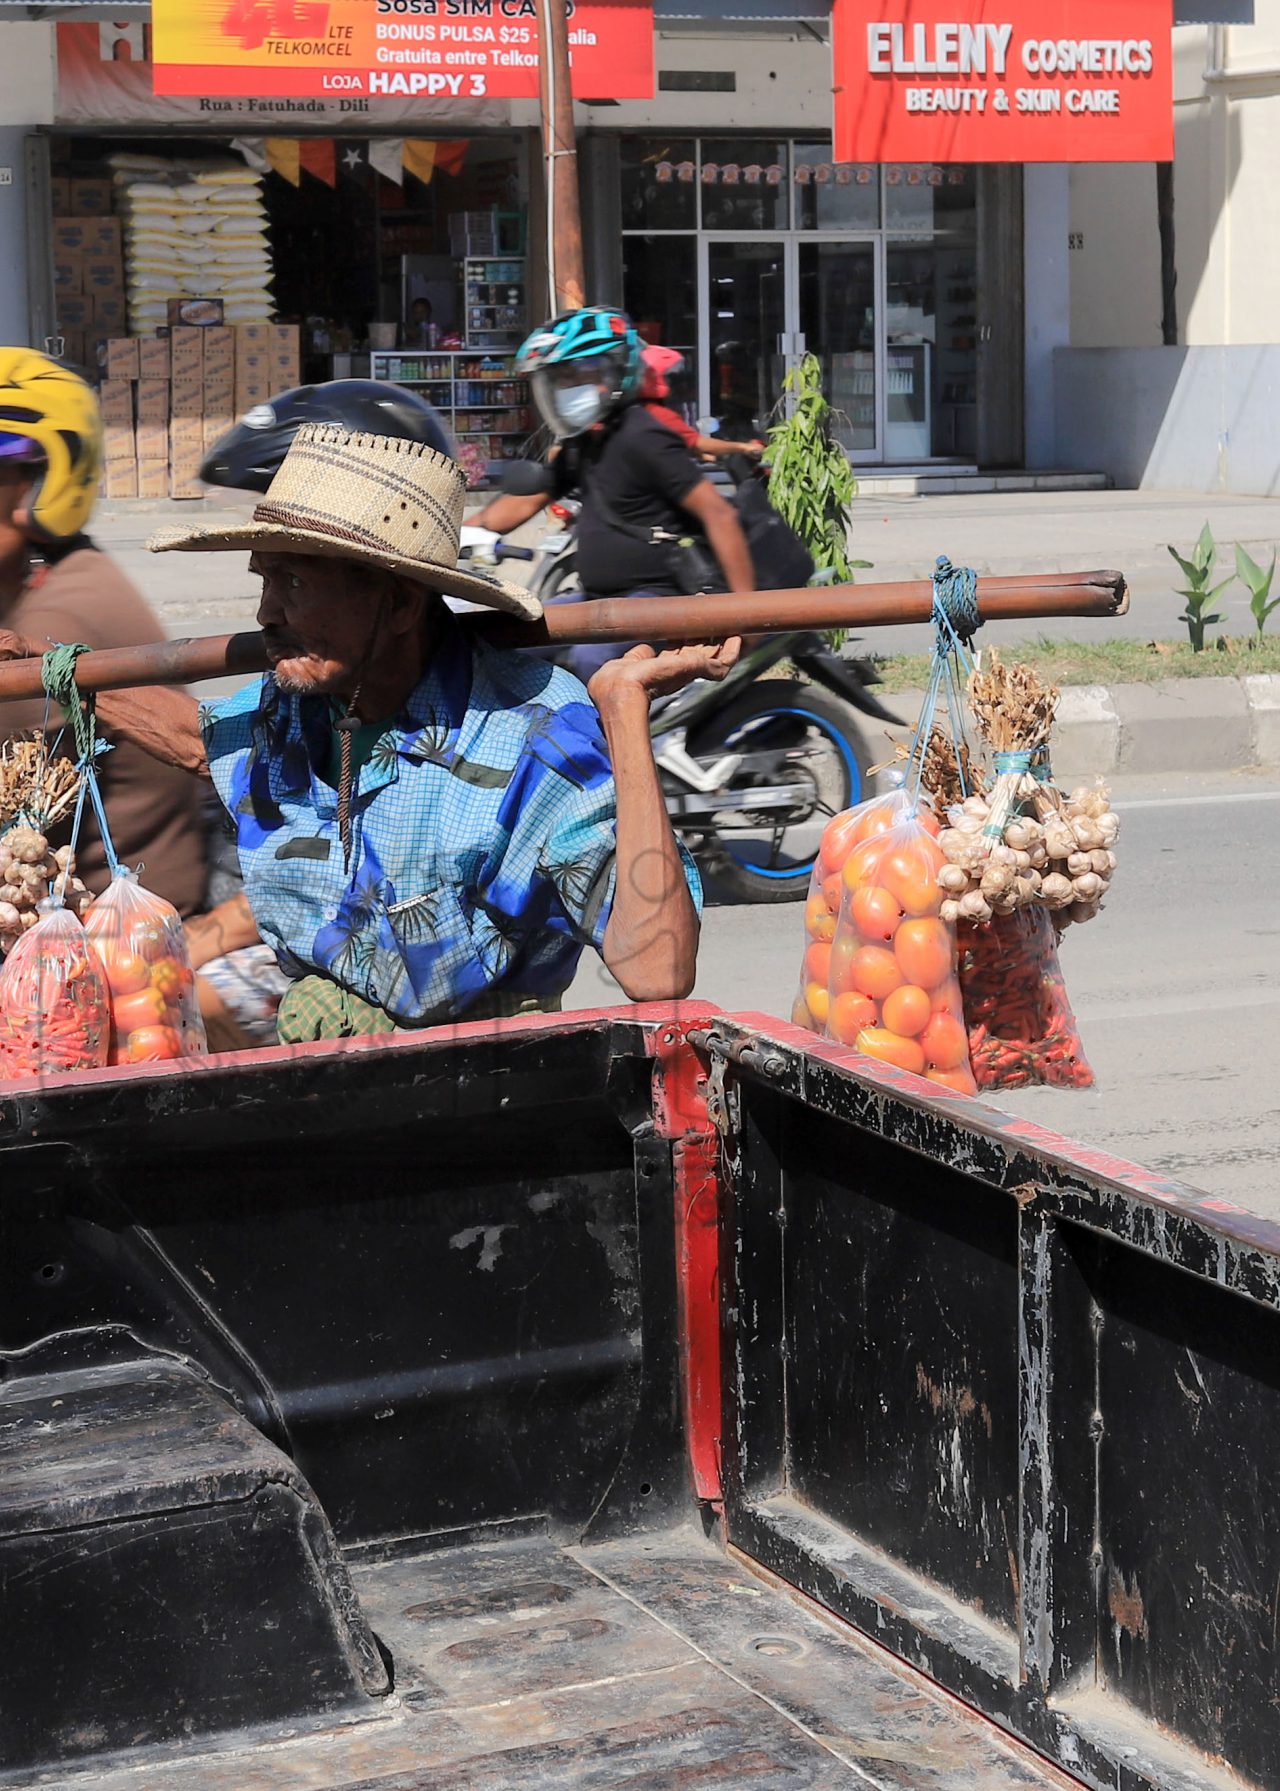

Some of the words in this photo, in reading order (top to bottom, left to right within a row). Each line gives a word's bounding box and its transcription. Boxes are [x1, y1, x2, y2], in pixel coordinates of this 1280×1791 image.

[377, 0, 437, 14] Sosa
[446, 0, 492, 15] SIM
[329, 26, 353, 39] LTE
[376, 23, 436, 40] BONUS
[440, 25, 496, 42] PULSA
[499, 25, 530, 44] $25
[266, 41, 352, 56] TELKOMCEL
[376, 46, 442, 64] Gratuita
[445, 50, 487, 65] entre
[867, 23, 1012, 74] ELLENY
[1021, 39, 1152, 73] COSMETICS
[322, 75, 363, 89] LOJA
[369, 72, 464, 95] HAPPY
[469, 74, 486, 96] 3
[200, 98, 233, 112] Rua
[248, 98, 326, 112] Fatuhada
[340, 99, 369, 112] Dili
[905, 88, 988, 112] BEAUTY
[992, 88, 1010, 112] &
[1015, 88, 1061, 112] SKIN
[1065, 89, 1120, 113] CARE
